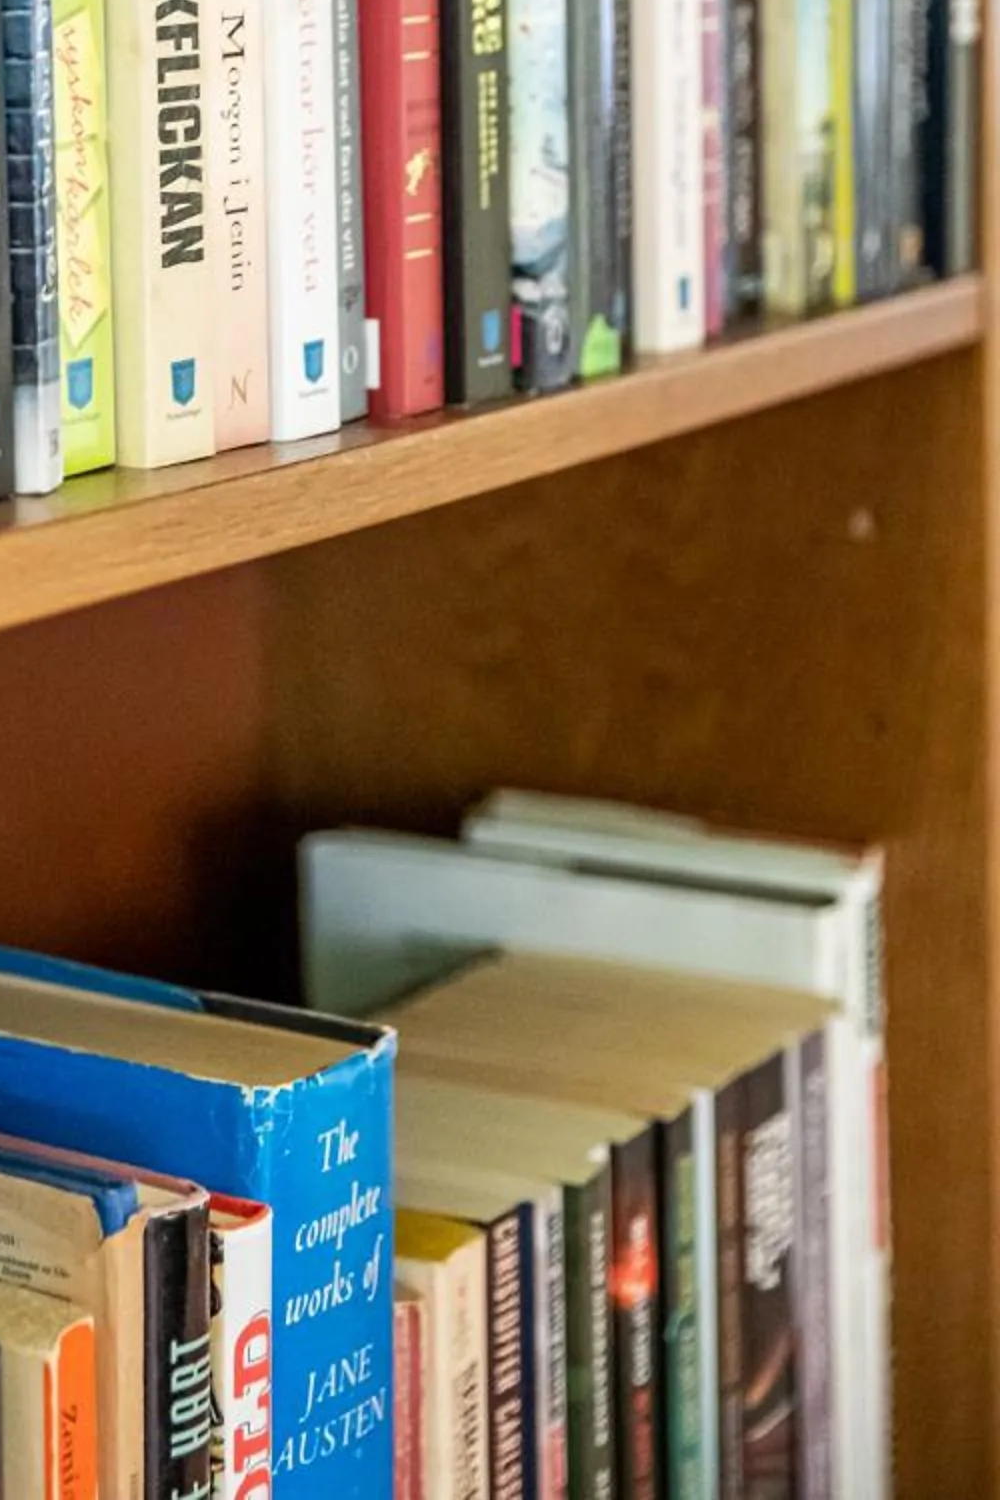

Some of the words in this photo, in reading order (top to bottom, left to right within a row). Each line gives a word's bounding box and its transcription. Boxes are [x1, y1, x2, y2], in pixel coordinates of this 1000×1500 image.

[219, 13, 248, 165] Morgon
[338, 49, 351, 88] det
[339, 94, 352, 138] vad
[340, 145, 353, 187] fan
[341, 189, 354, 224] du
[223, 196, 253, 292] Jenin
[302, 210, 321, 295] veta
[342, 228, 355, 270] vill
[316, 1117, 360, 1173] The
[294, 1180, 382, 1253] complete
[284, 1259, 354, 1326] works
[361, 1233, 385, 1302] of
[492, 1216, 521, 1396] CHRISTOFFER
[169, 1331, 212, 1458] HART
[299, 1342, 375, 1424] JANE
[271, 1387, 388, 1476] AUSTEN
